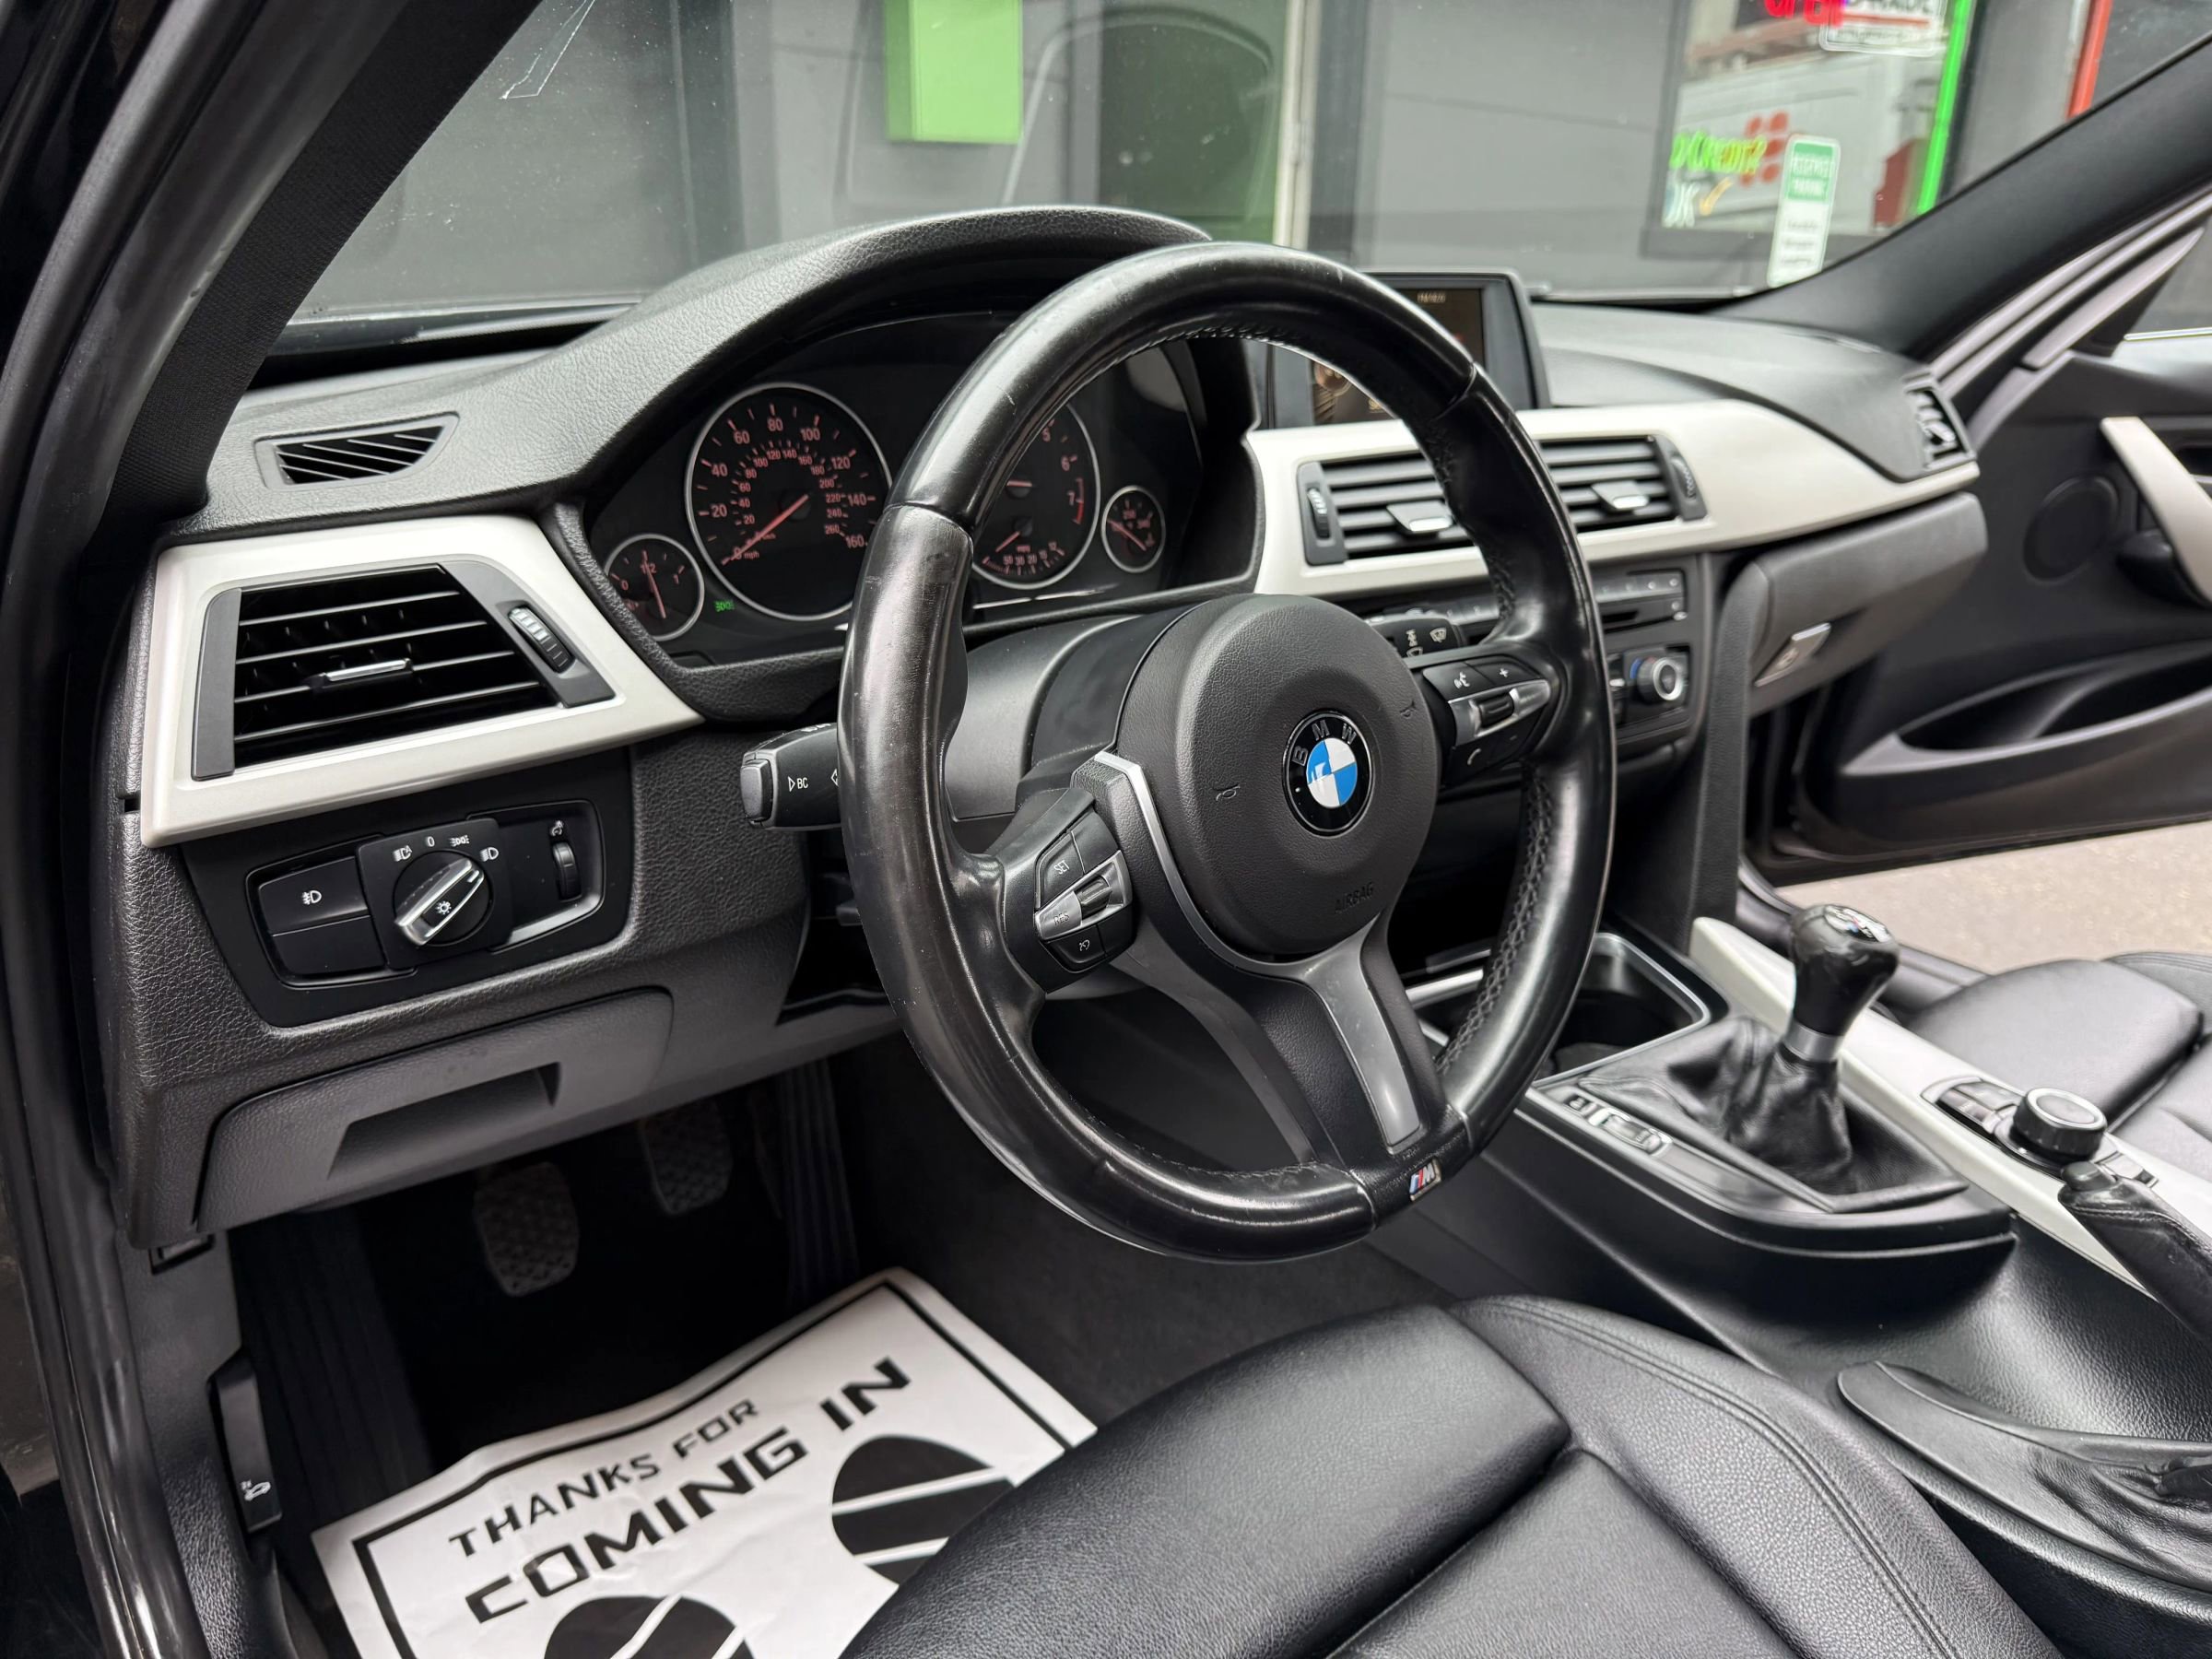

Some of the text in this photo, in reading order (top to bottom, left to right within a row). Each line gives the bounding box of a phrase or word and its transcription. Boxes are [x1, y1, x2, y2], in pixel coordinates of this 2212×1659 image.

[768, 418, 782, 431] 80
[734, 430, 750, 444] 60
[801, 428, 820, 441] 100
[767, 449, 782, 460] 120
[783, 449, 797, 459] 140
[753, 457, 768, 467] 100
[831, 457, 851, 469] 120
[712, 463, 728, 477] 40
[819, 478, 834, 488] 200
[738, 498, 750, 508] 40
[826, 493, 841, 503] 220
[848, 493, 866, 505] 140
[1066, 490, 1076, 506] 7
[711, 503, 727, 517] 20
[827, 508, 842, 518] 240
[744, 514, 755, 524] 20
[845, 535, 865, 547] 160
[1291, 719, 1357, 767] BMW
[797, 777, 809, 789] BC
[1053, 859, 1070, 875] SET
[1335, 882, 1373, 913] AIRBAG
[1053, 911, 1070, 925] RES
[449, 1398, 759, 1557] THANKS FOR
[465, 1355, 912, 1624] COMING IN
